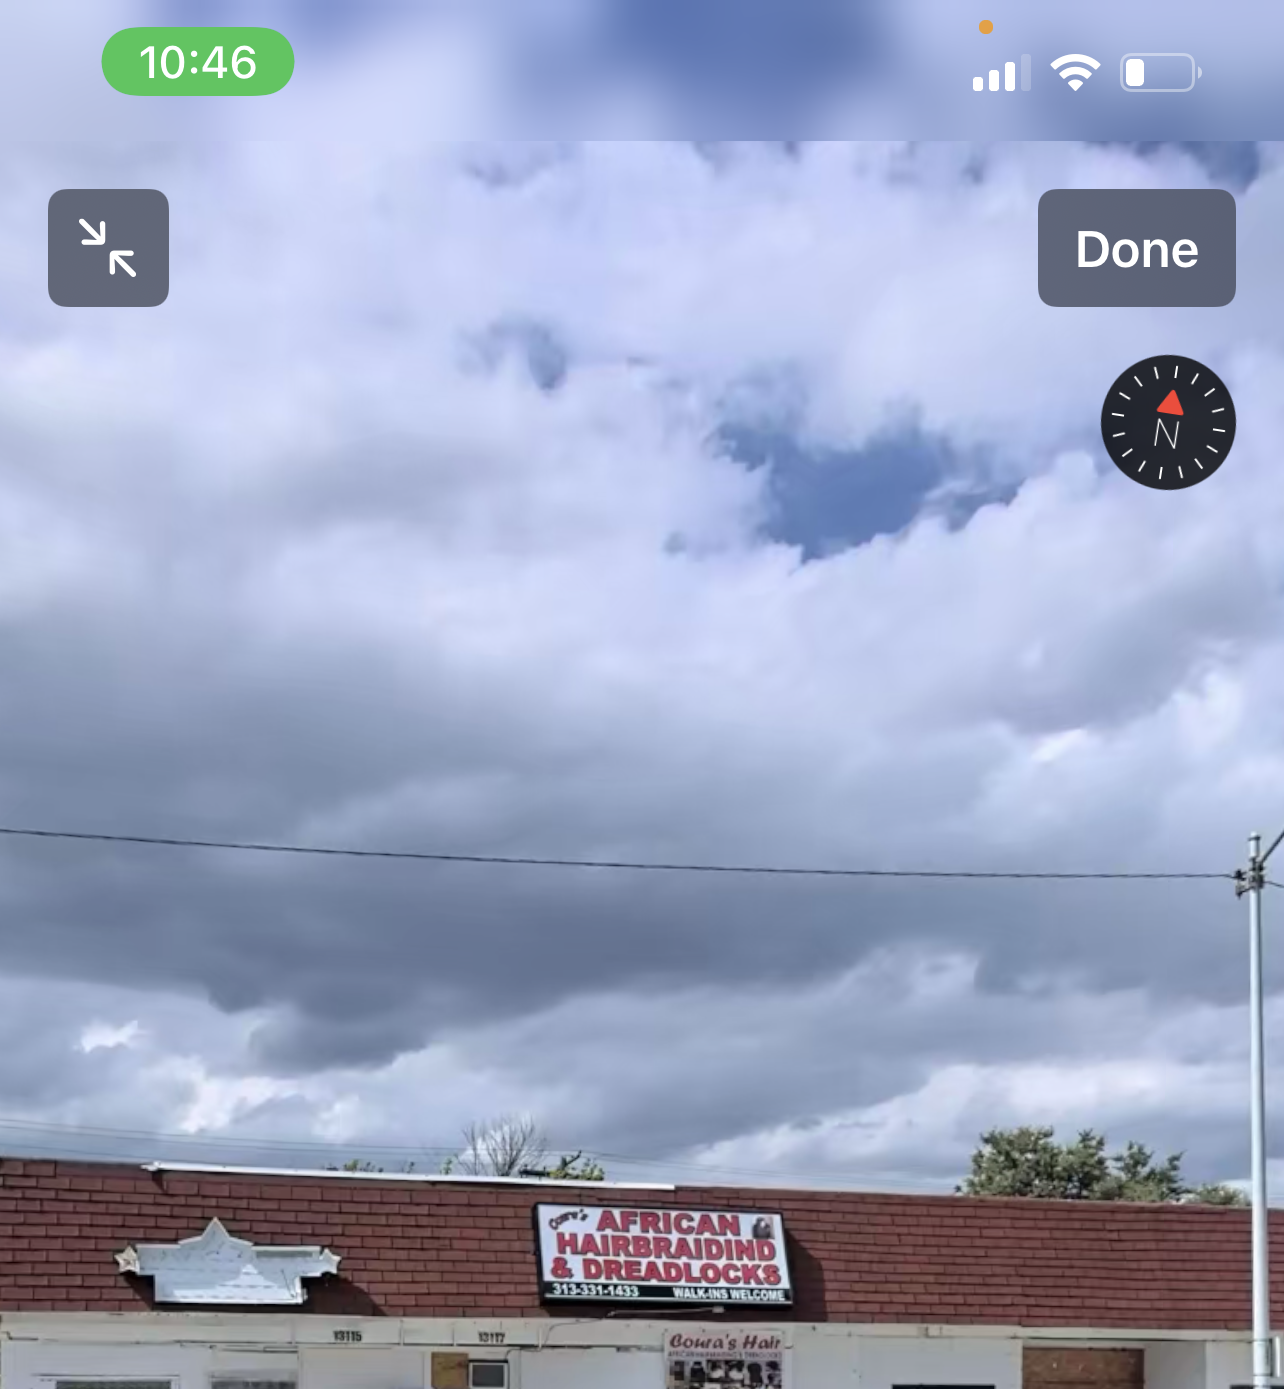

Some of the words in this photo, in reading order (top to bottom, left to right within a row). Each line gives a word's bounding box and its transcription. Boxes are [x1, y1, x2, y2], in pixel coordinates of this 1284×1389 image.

[596, 1210, 741, 1236] AFRICAN
[556, 1232, 776, 1261] HAIRBRAIDIND
[551, 1257, 574, 1279] &
[582, 1258, 782, 1286] DREADLOCKS
[552, 1283, 639, 1297] 313-331-1433
[673, 1287, 727, 1299] WALK-INS
[729, 1289, 786, 1301] WELCOME
[333, 1331, 362, 1342] 13115
[478, 1332, 506, 1343] 13117
[743, 1334, 781, 1350] Hair
